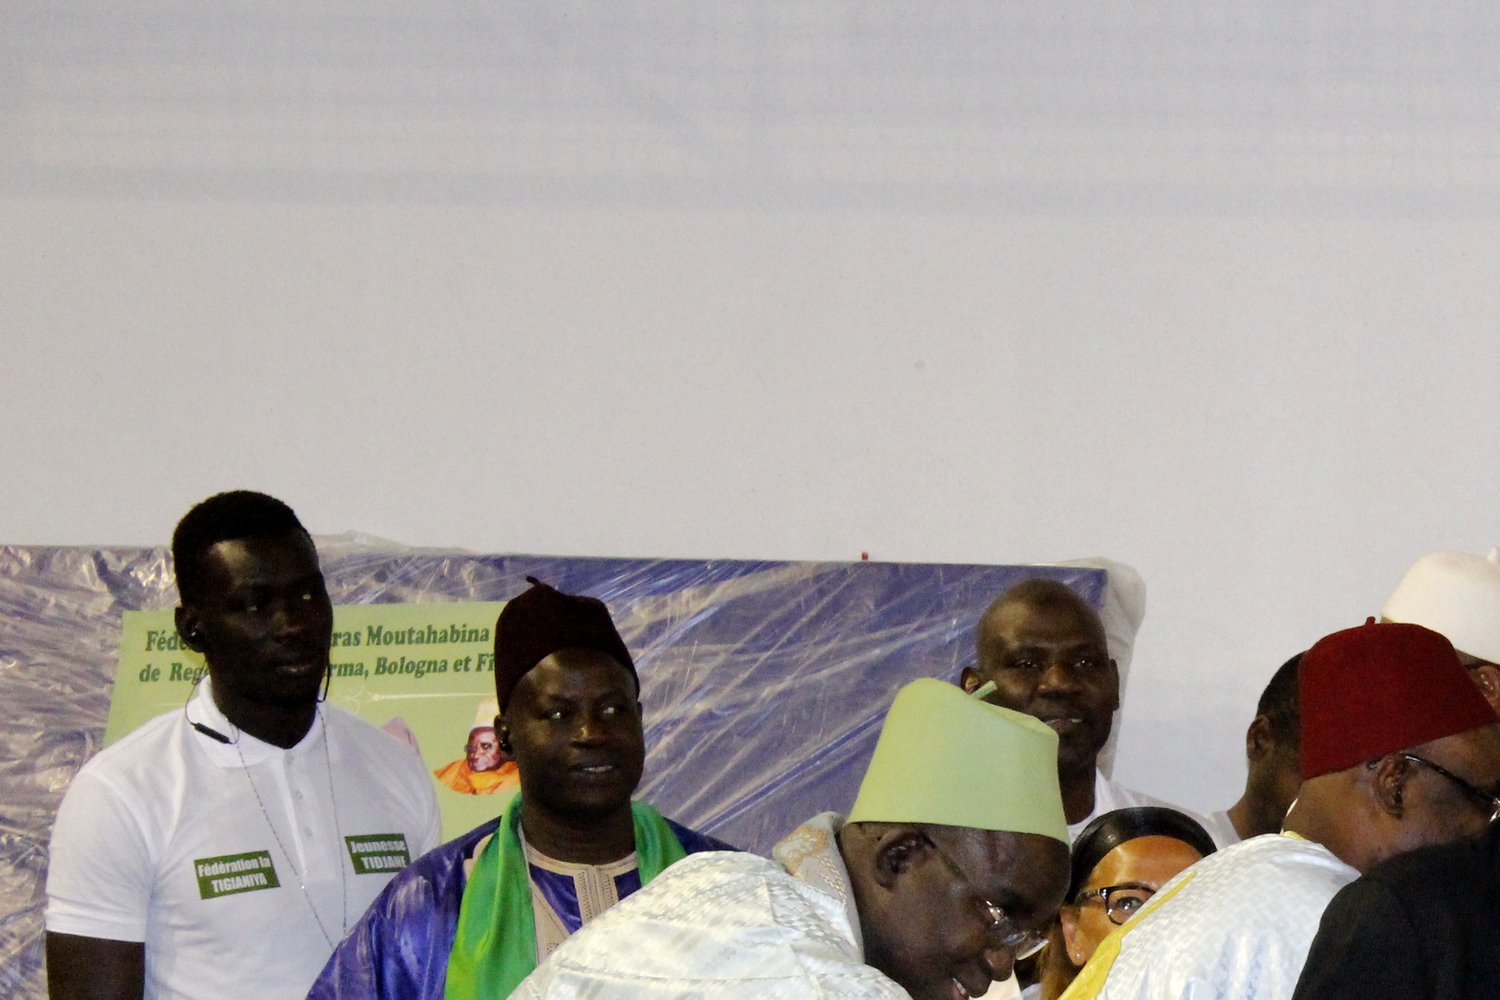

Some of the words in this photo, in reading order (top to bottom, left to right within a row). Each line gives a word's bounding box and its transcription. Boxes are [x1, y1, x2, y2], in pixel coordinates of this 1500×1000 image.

[366, 624, 490, 646] Moutahabina
[139, 664, 161, 682] de
[374, 656, 448, 678] Bologna
[453, 656, 472, 672] et
[350, 840, 407, 855] Jeunesse
[198, 858, 260, 878] Fédération
[258, 856, 272, 868] la
[211, 872, 268, 893] TIGIANIYA
